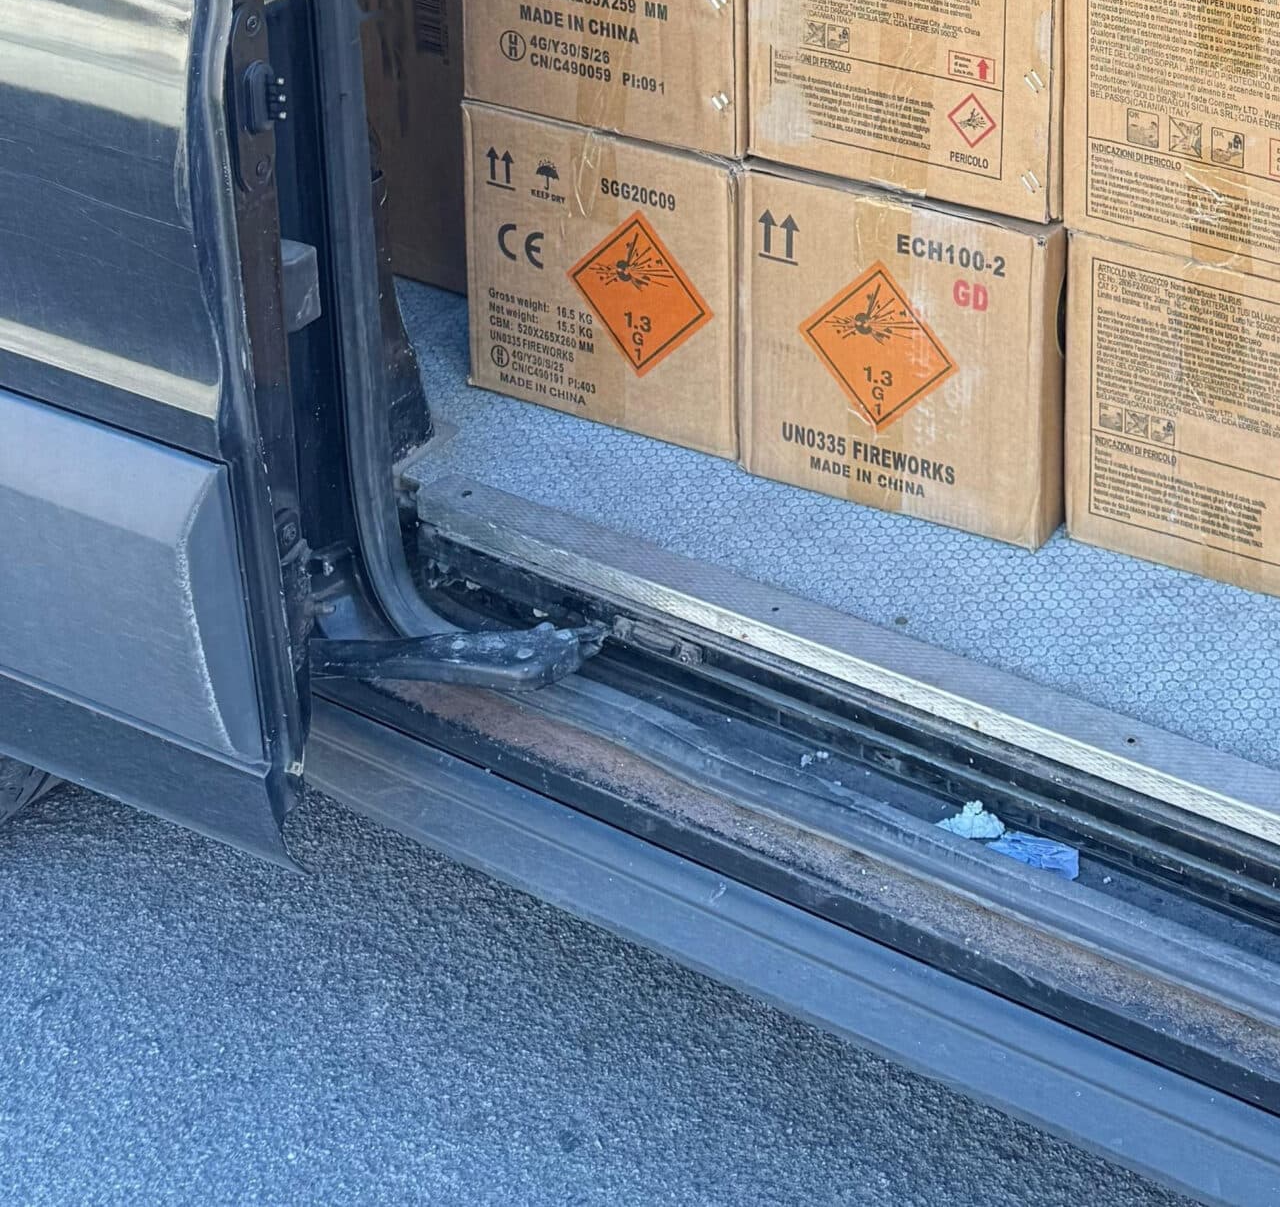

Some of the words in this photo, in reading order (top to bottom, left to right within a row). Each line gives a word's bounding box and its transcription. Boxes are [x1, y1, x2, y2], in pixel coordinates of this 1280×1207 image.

[1237, 4, 1252, 14] USO
[1254, 7, 1280, 19] SICURO
[1133, 90, 1155, 101] GOLD
[950, 151, 988, 169] PERICOLO
[1092, 143, 1134, 159] INDICAZIONI
[1136, 152, 1142, 160] DI
[1145, 154, 1181, 170] PERICOLO
[601, 178, 675, 210] SGG20C09
[897, 234, 1005, 277] ECH100-2
[953, 279, 988, 311] GD
[624, 311, 651, 332] 1.3
[632, 332, 643, 345] G
[636, 348, 640, 360] 1
[864, 366, 892, 386] 1.3
[872, 387, 883, 400] G
[875, 403, 881, 415] 1
[782, 422, 845, 455] UN0335
[853, 442, 955, 485] FIREWORKS
